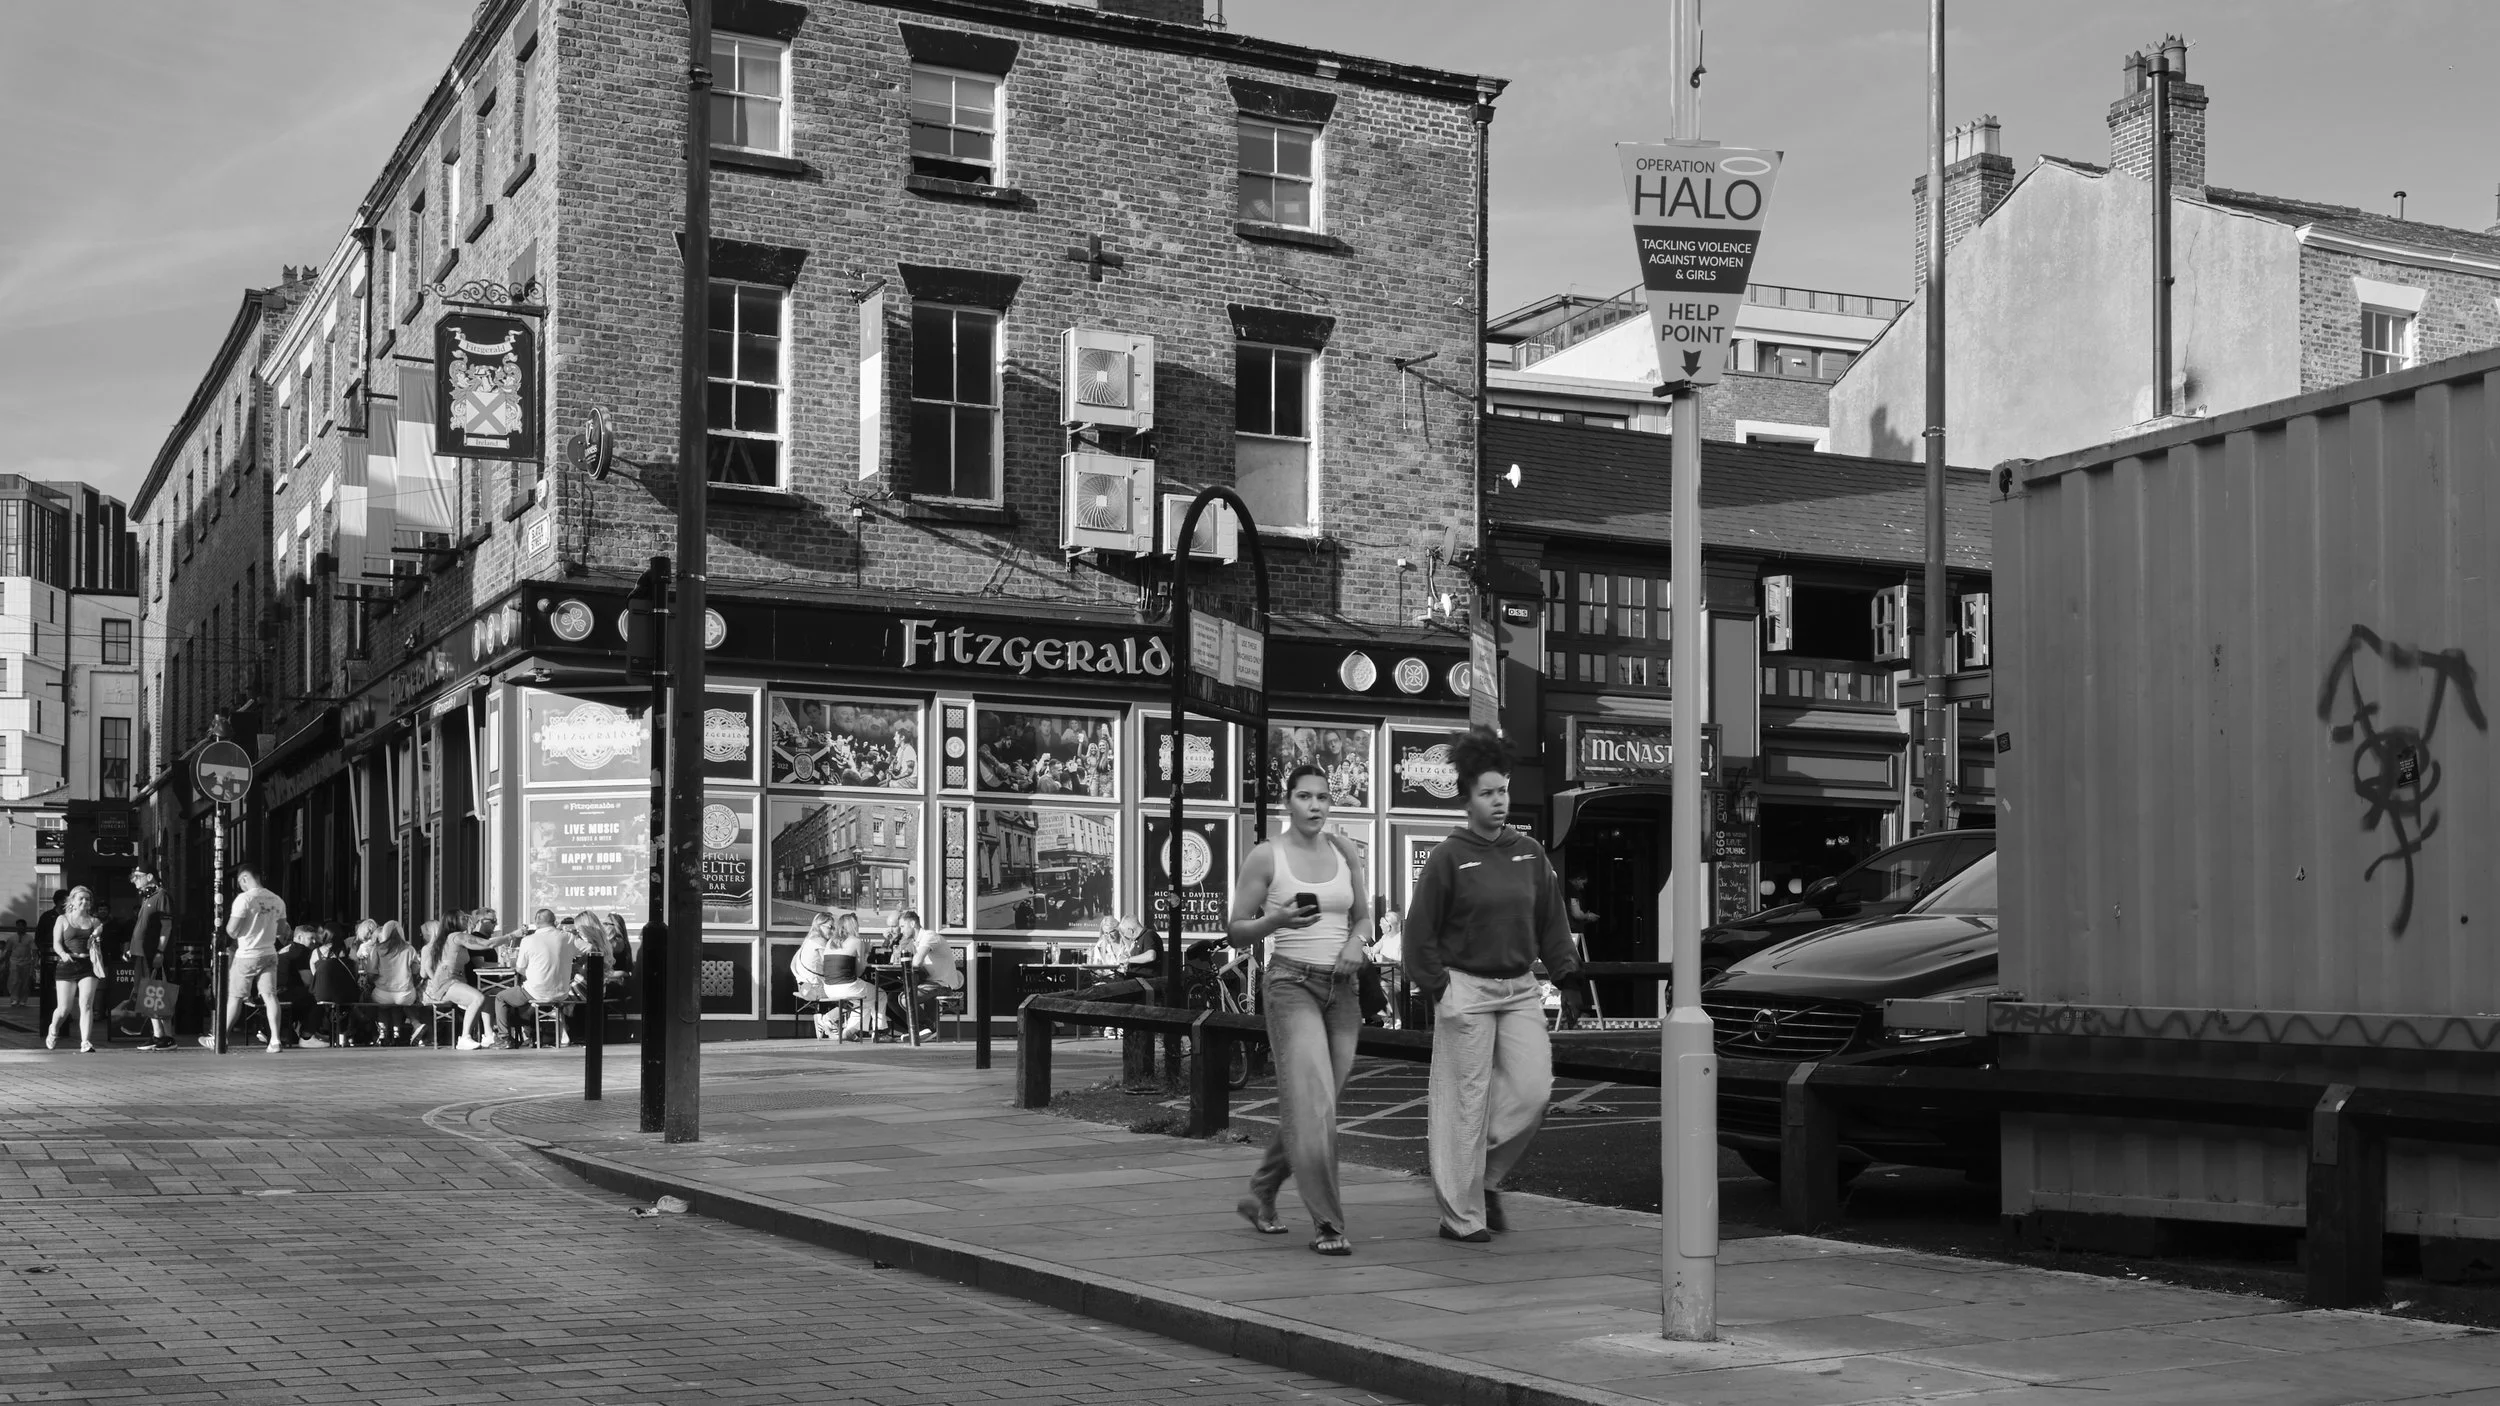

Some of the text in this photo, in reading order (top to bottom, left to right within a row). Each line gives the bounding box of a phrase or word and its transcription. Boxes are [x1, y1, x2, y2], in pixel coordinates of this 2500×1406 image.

[1636, 158, 1716, 173] OPERATION
[1634, 175, 1762, 220] HALO
[1642, 239, 1752, 254] TACKLING VIOLENCE
[1648, 254, 1744, 268] AGAINST WOMEN
[1675, 269, 1717, 281] & GIRLS
[1669, 303, 1720, 322] HELP
[1661, 324, 1725, 344] POINT
[564, 822, 620, 835] LIVE MUSIC
[1715, 831, 1725, 856] 999
[561, 852, 622, 864] HAPPY HOUR
[703, 853, 740, 861] FFICIAL
[702, 861, 746, 874] ELTIC
[703, 874, 745, 883] PORTERS
[565, 885, 618, 897] LIVE SPORT
[1154, 898, 1218, 912] CTIC
